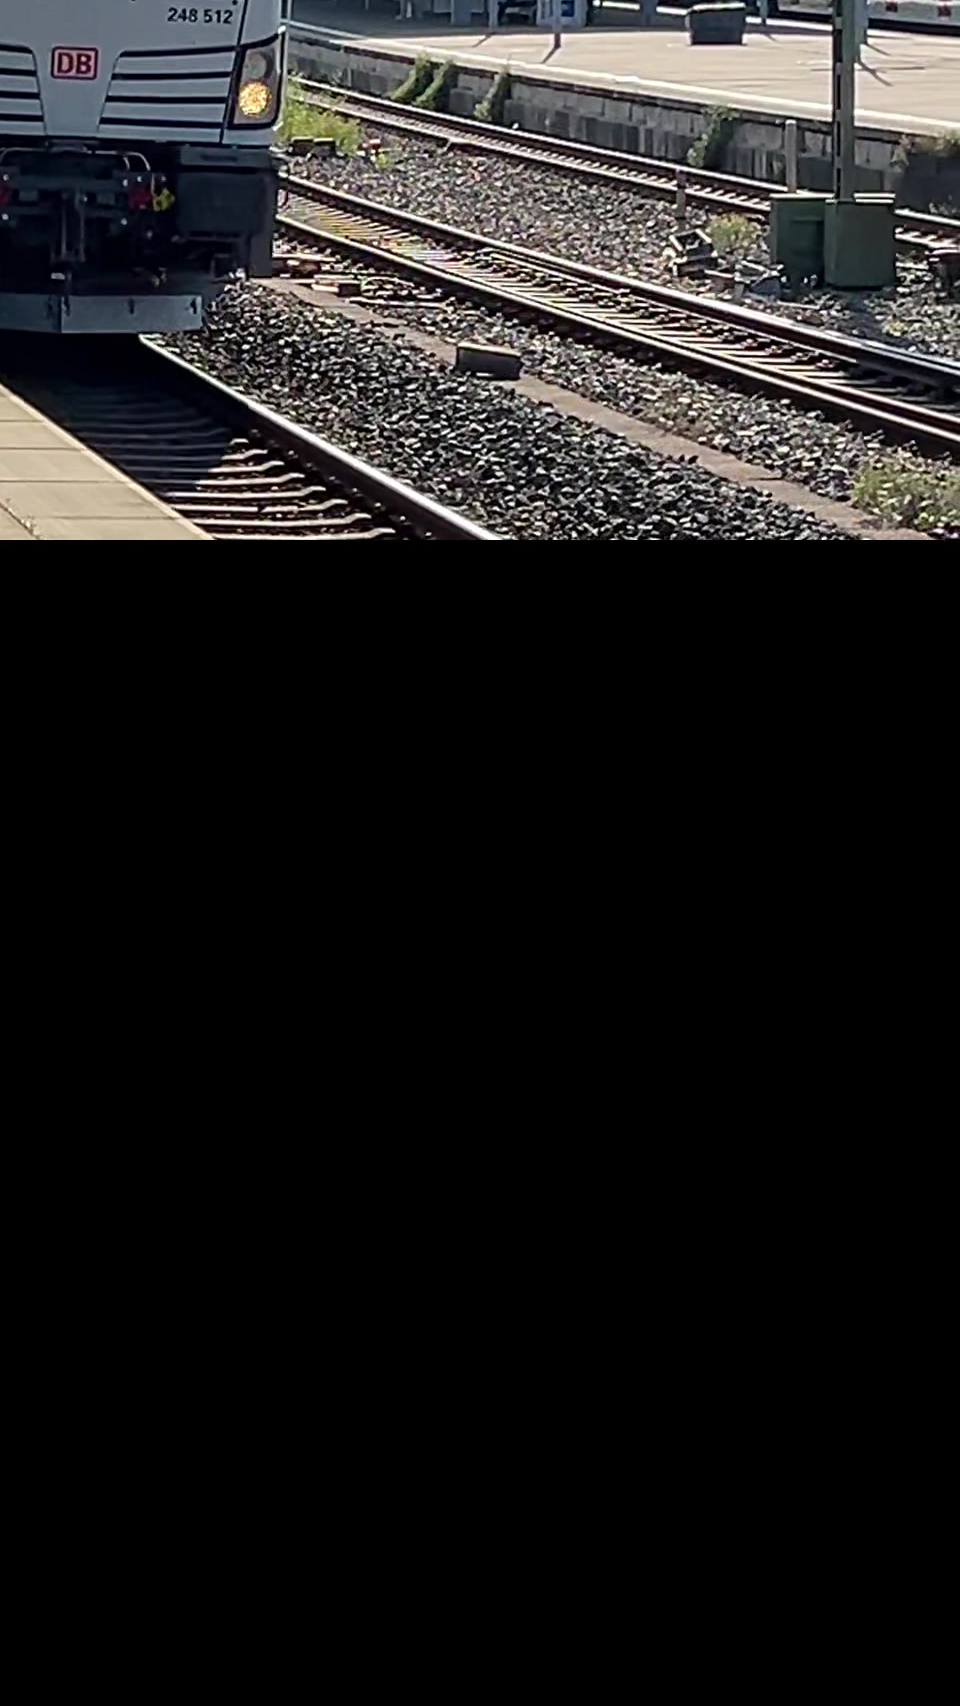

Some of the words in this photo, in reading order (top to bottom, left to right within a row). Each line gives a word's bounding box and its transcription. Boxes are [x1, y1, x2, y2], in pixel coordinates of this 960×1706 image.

[167, 7, 198, 22] 248
[203, 9, 233, 24] 512
[57, 52, 92, 74] DB
